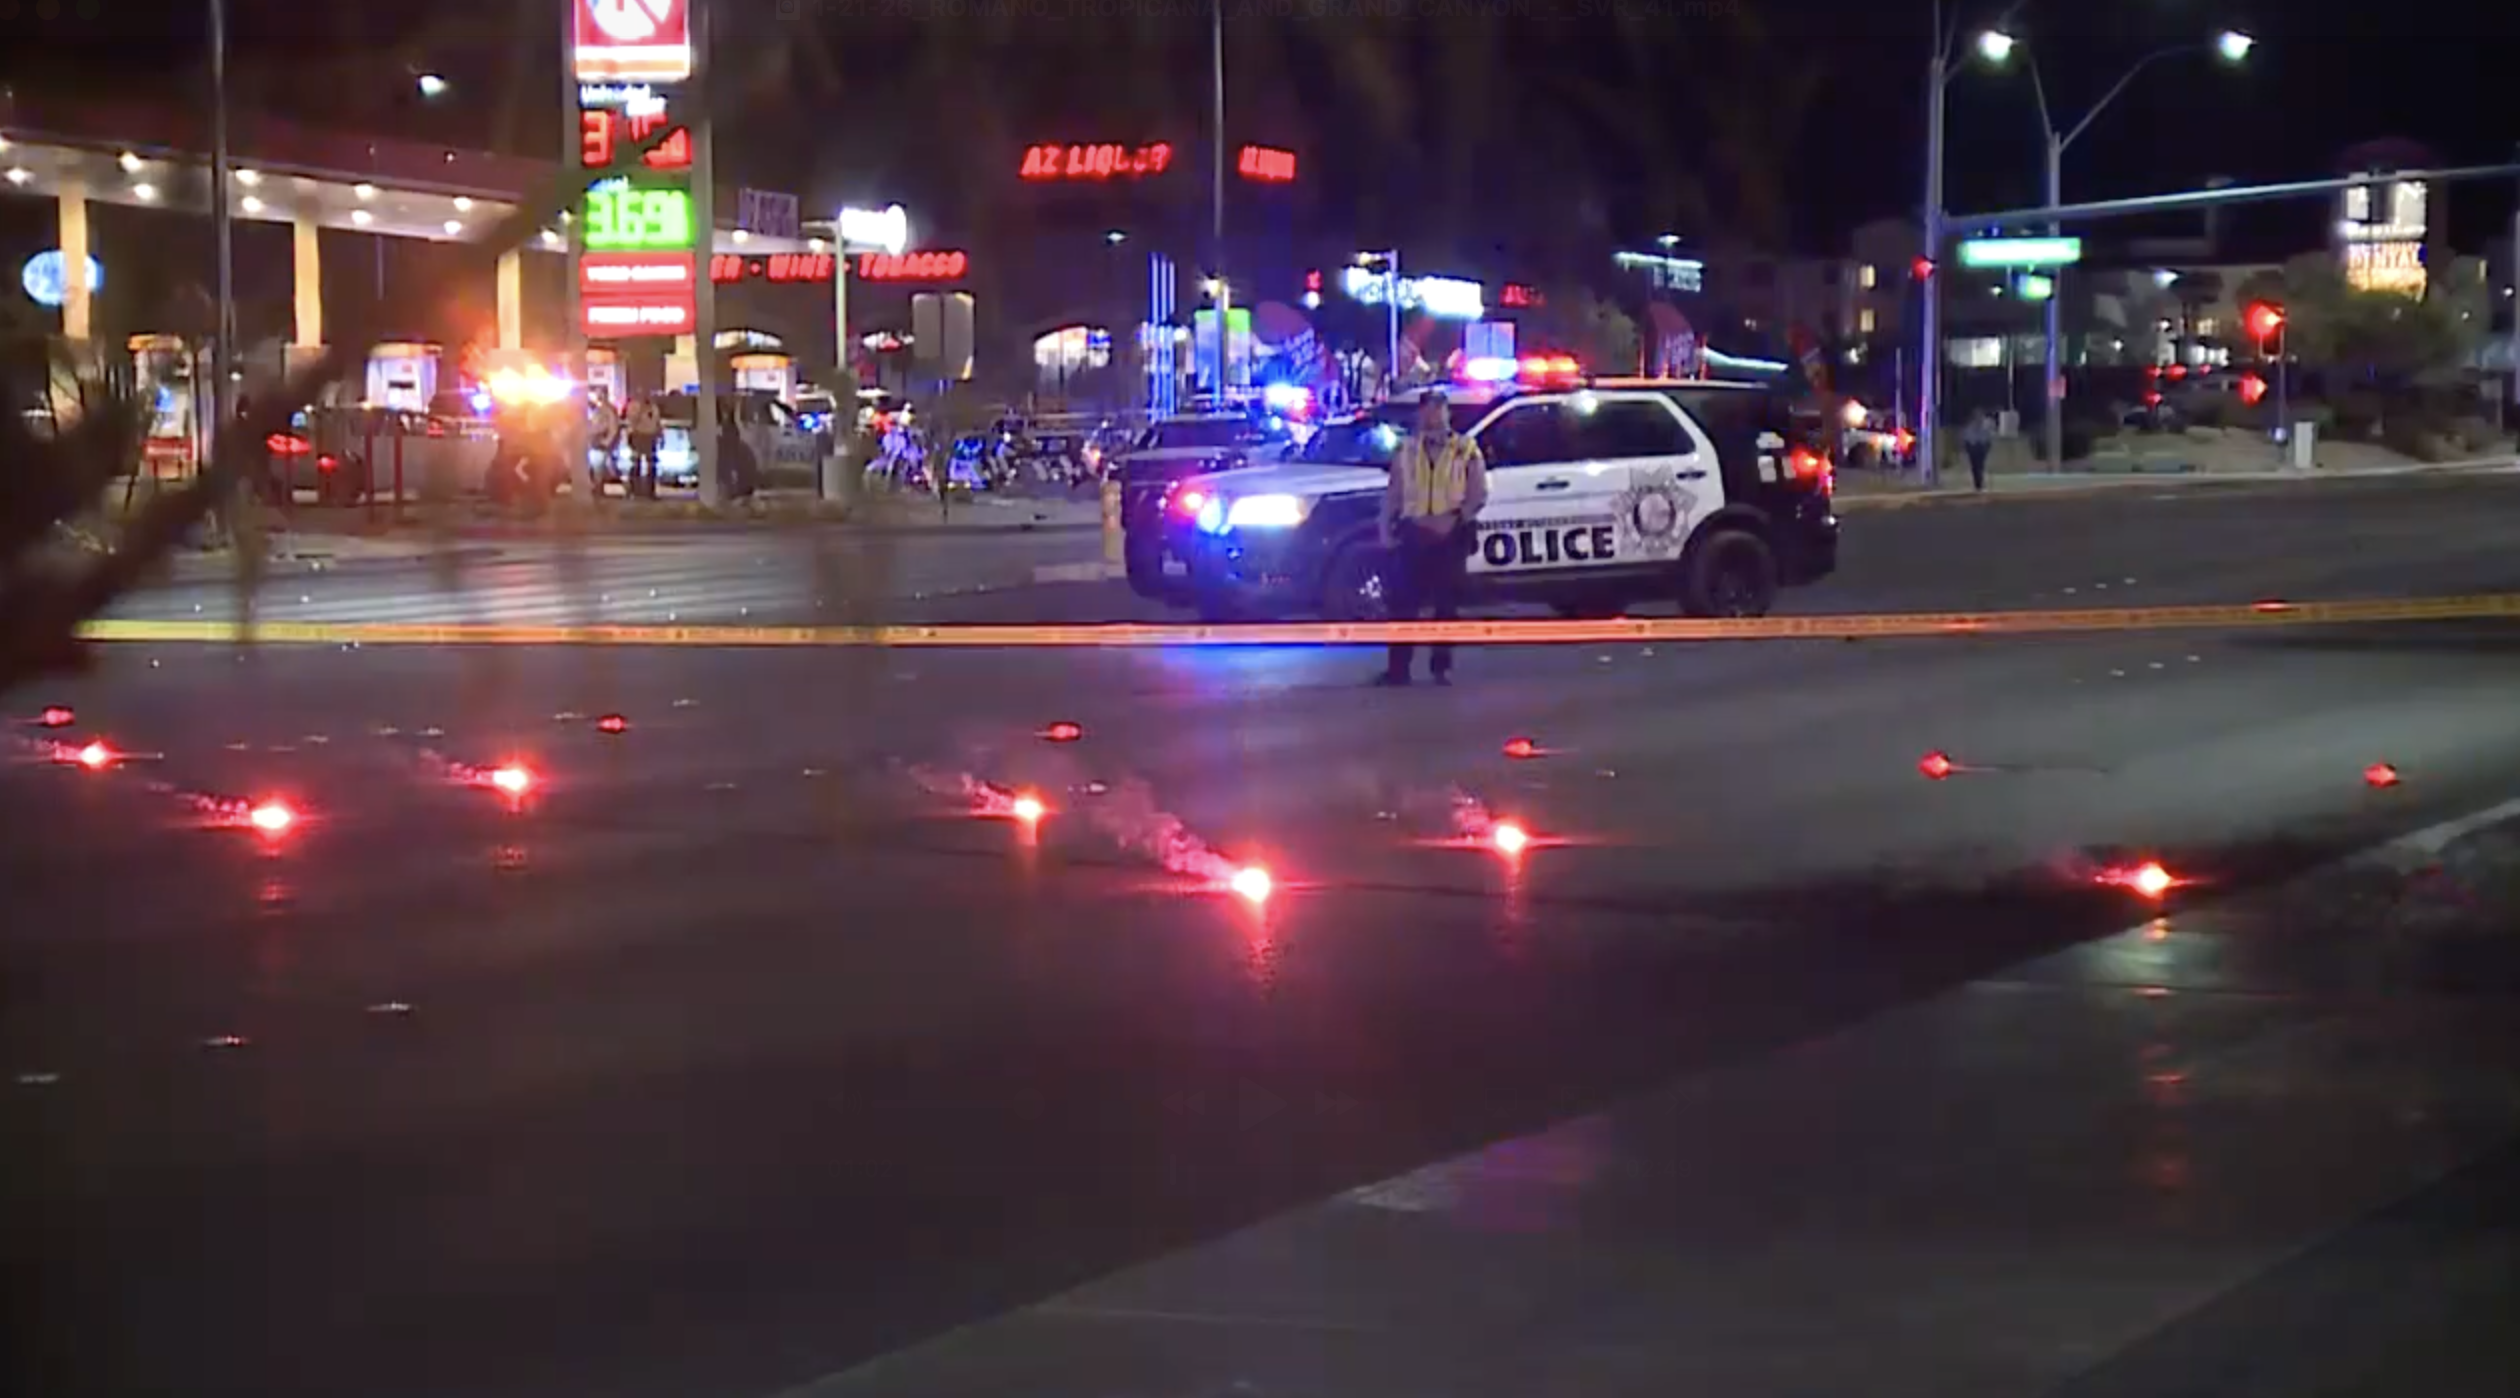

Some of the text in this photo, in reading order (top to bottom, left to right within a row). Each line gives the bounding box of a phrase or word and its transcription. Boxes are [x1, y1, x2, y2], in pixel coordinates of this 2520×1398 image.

[1020, 144, 1062, 177] AZ
[766, 253, 834, 281] WINE
[858, 250, 967, 281] TOBACCO
[1469, 525, 1616, 567] OLICE
